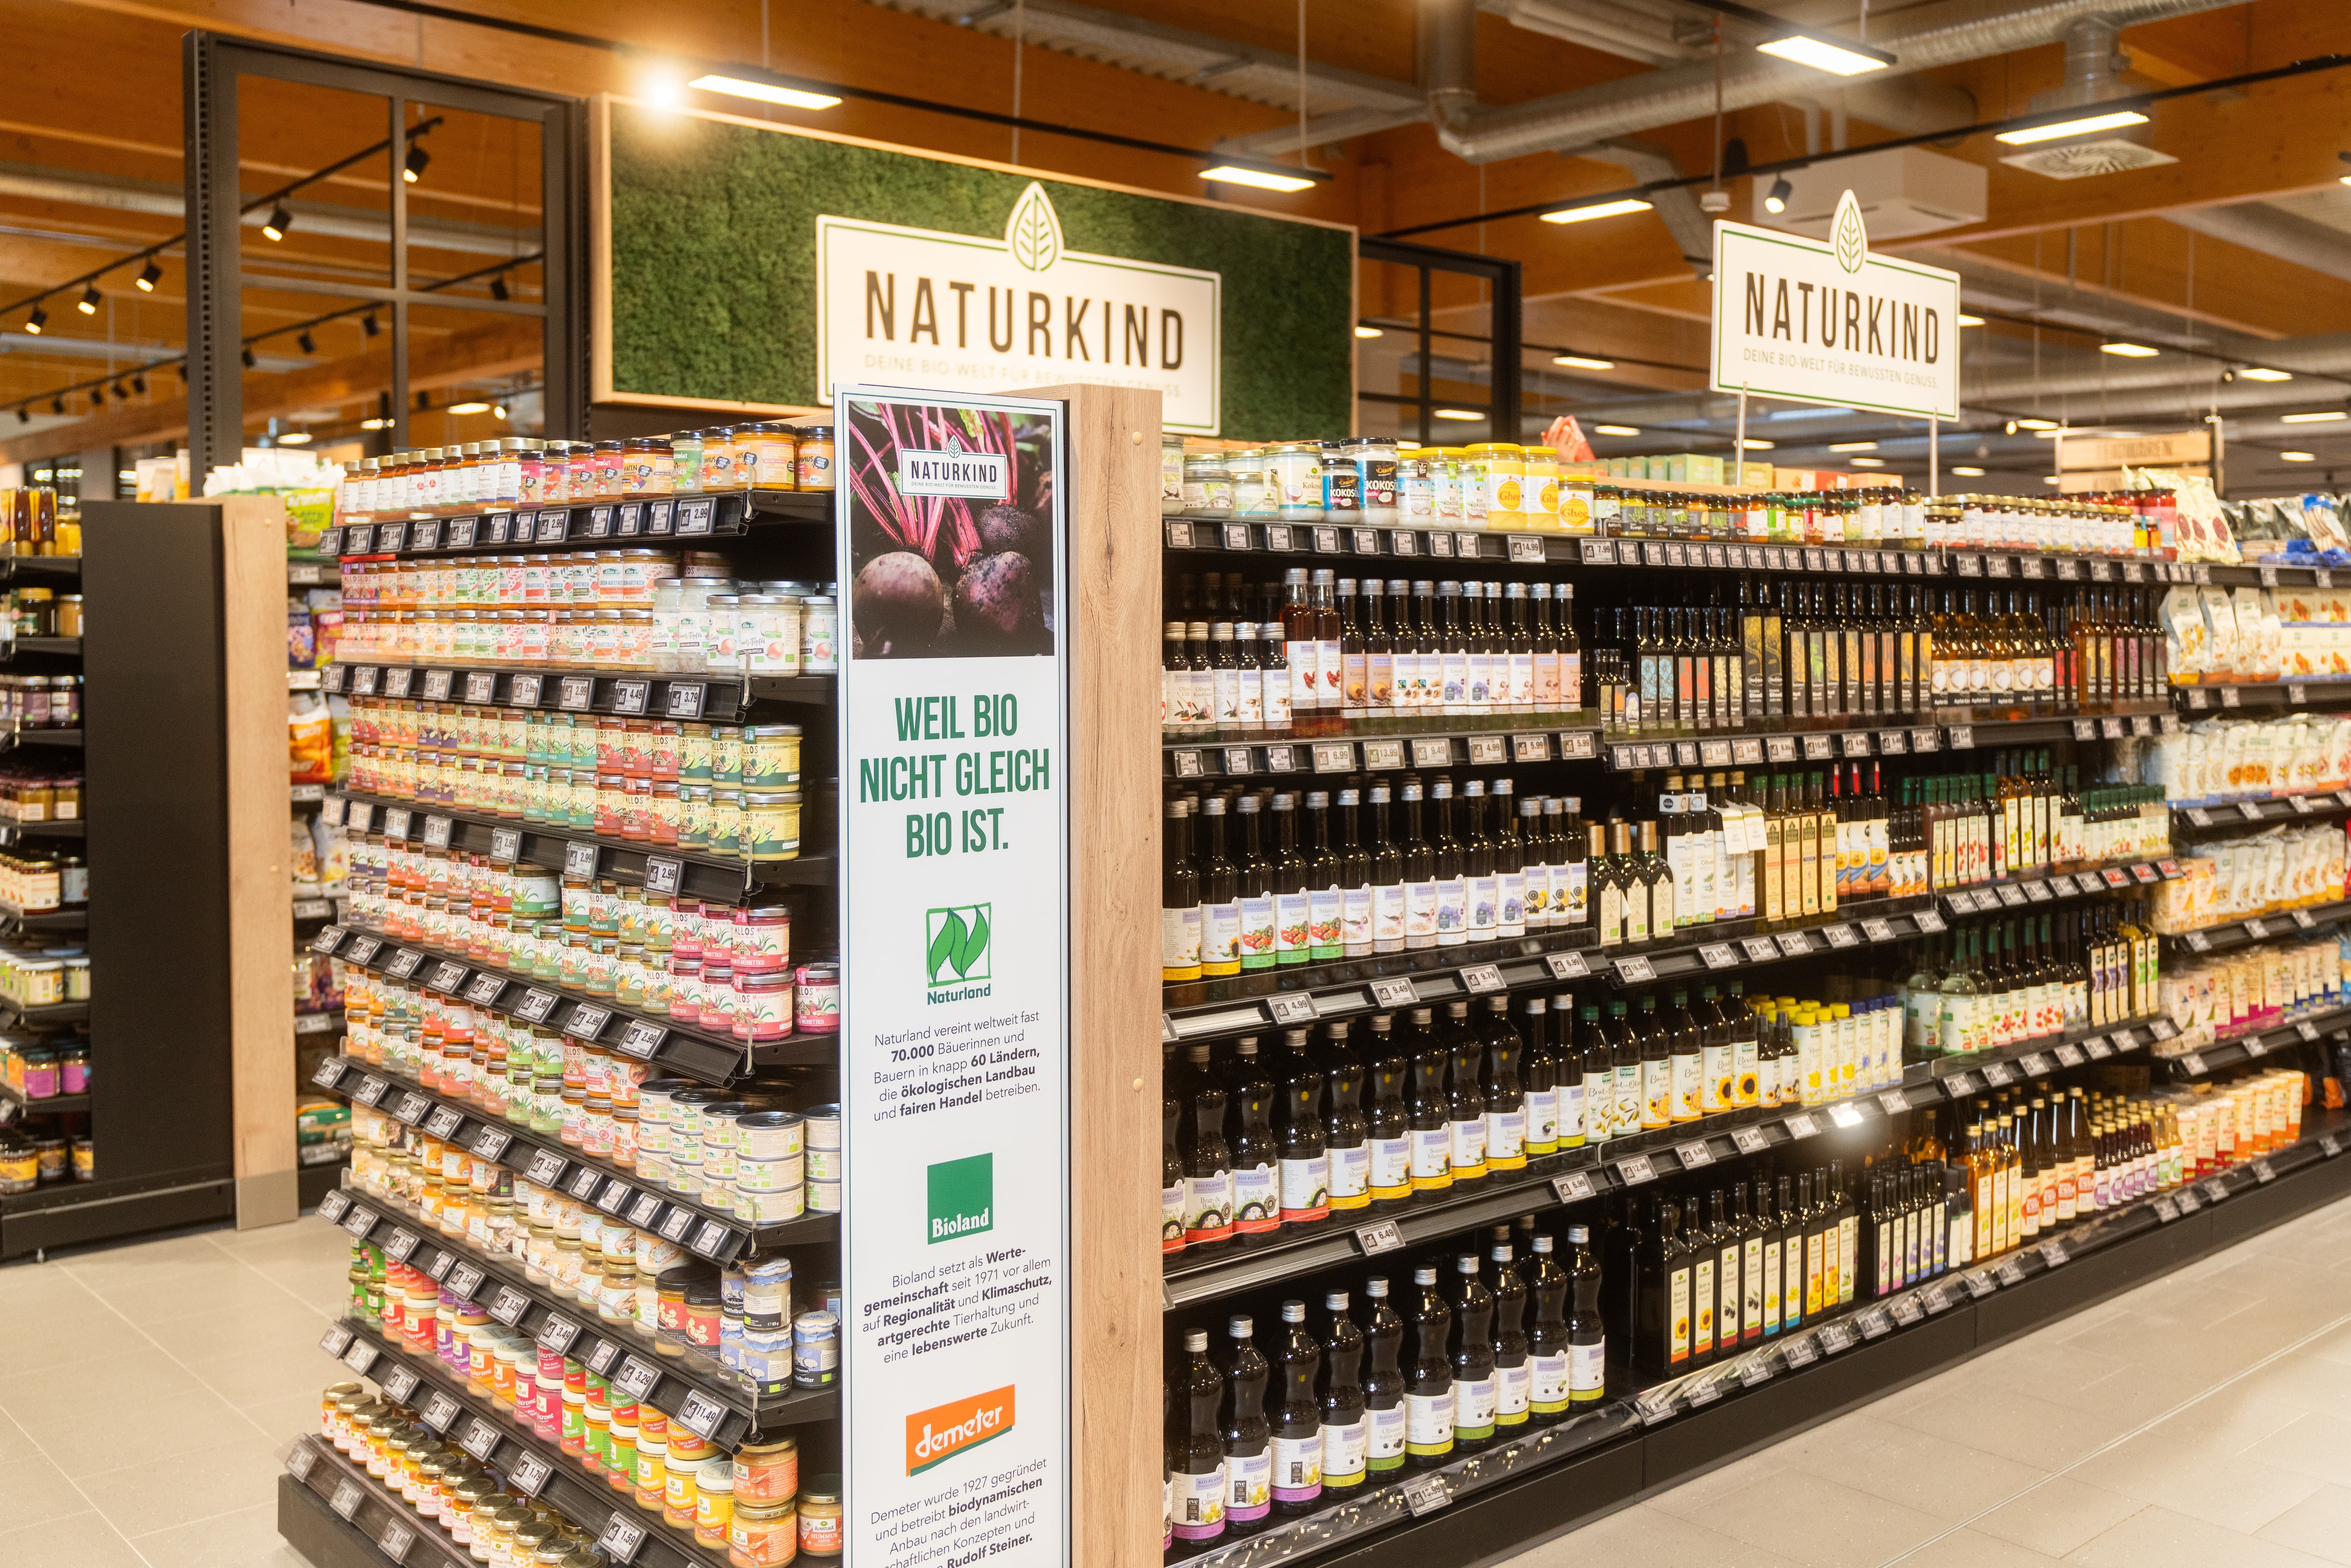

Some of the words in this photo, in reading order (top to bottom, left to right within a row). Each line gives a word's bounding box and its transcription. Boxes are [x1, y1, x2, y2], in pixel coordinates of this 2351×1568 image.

[865, 270, 1184, 371] NATURKIND
[1745, 271, 1938, 364] NATURKIND
[865, 354, 914, 371] DEINE
[921, 359, 995, 378] BIO-WELT
[1002, 367, 1030, 382] FÜR
[1744, 348, 1775, 364] DEINE
[1779, 354, 1825, 371] BIO-WELT
[1828, 359, 1845, 374] FÜR
[1849, 365, 1901, 382] BEWUSSTEN
[1904, 373, 1938, 388] GENUSS.
[911, 461, 997, 482] NATURKIND
[694, 508, 708, 519] 2.99
[1562, 508, 1587, 517] Ghee
[461, 525, 472, 535] 3.49
[551, 518, 563, 529] 2.99
[479, 681, 489, 690] 2.99
[575, 686, 587, 696] 2.99
[630, 689, 642, 699] 4.49
[685, 692, 698, 703] 3.79
[895, 696, 965, 741] WEIL
[974, 693, 1017, 738] BIO
[1380, 749, 1397, 757] 13.99
[1431, 746, 1445, 755] 9.49
[1531, 741, 1543, 749] 5.99
[1333, 751, 1348, 760] 6.99
[860, 754, 946, 803] NICHT
[956, 749, 1049, 796] GLEICH
[907, 812, 952, 858] BIO
[962, 808, 1008, 853] IST.
[504, 837, 515, 849] 2.99
[662, 868, 675, 880] 2.99
[1481, 971, 1495, 980] 9.79
[928, 983, 991, 1005] Naturland
[1392, 985, 1408, 993] 9.49
[535, 997, 550, 1009] 2.99
[1291, 1000, 1308, 1009] 4.99
[641, 1032, 657, 1044] 2.99
[875, 1026, 931, 1047] Naturland
[934, 1022, 971, 1037] vereint
[974, 1014, 1018, 1031] weltweit
[1021, 1011, 1040, 1023] fast
[891, 1044, 934, 1062] 70.000
[939, 1037, 1000, 1055] Bäuerinnen
[1004, 1030, 1024, 1043] und
[874, 1070, 915, 1084] Bauern
[919, 1064, 928, 1076] in
[932, 1059, 967, 1075] knapp
[971, 1054, 986, 1067] 60
[990, 1047, 1040, 1064] Ländern,
[879, 1089, 897, 1102] die
[901, 1075, 982, 1097] ökologischen
[986, 1064, 1035, 1082] Landbau
[874, 1106, 896, 1121] und
[900, 1100, 935, 1117] fairen
[940, 1090, 982, 1109] Handel
[986, 1083, 1040, 1101] betreiben.
[544, 1160, 558, 1173] 3.29
[932, 1207, 989, 1237] Bioland
[1378, 1229, 1394, 1239] 6.49
[893, 1266, 935, 1287] Bioland
[939, 1261, 965, 1276] setzt
[969, 1256, 983, 1269] als
[986, 1247, 1026, 1264] Werte-
[864, 1281, 948, 1316] gemeinschaft
[952, 1277, 971, 1291] seit
[975, 1269, 998, 1284] 1971
[1003, 1268, 1020, 1278] vor
[1023, 1258, 1050, 1273] allem
[863, 1316, 881, 1332] auf
[884, 1299, 955, 1326] Regionalität
[958, 1294, 978, 1308] und
[982, 1275, 1052, 1301] Klimaschutz,
[877, 1318, 950, 1346] artgerechte
[954, 1302, 1015, 1326] Tierhaltung
[1019, 1293, 1039, 1309] und
[557, 1328, 572, 1341] 3.49
[884, 1350, 908, 1363] eine
[912, 1327, 987, 1355] lebenswerte
[991, 1314, 1033, 1334] Zukunft.
[635, 1371, 651, 1386] 3.29
[685, 1408, 694, 1417] BIO
[696, 1405, 716, 1423] 11.49
[915, 1405, 1002, 1458] demeter
[871, 1501, 921, 1525] Demeter
[924, 1487, 959, 1506] wurde
[963, 1476, 987, 1494] 1927
[991, 1458, 1047, 1487] gegründet
[1421, 1485, 1441, 1498] 13.99
[876, 1523, 898, 1541] und
[902, 1509, 946, 1532] betreibt
[949, 1477, 1042, 1517] biodynamischen
[890, 1535, 927, 1555] Anbau
[931, 1523, 957, 1541] nach
[960, 1518, 980, 1530] den
[985, 1500, 1030, 1522] landwirt-
[954, 1522, 1011, 1551] Konzepten
[1015, 1512, 1035, 1529] und
[621, 1530, 635, 1545] 1.59
[947, 1546, 986, 1568] Rudolf
[989, 1532, 1033, 1555] Steiner.
